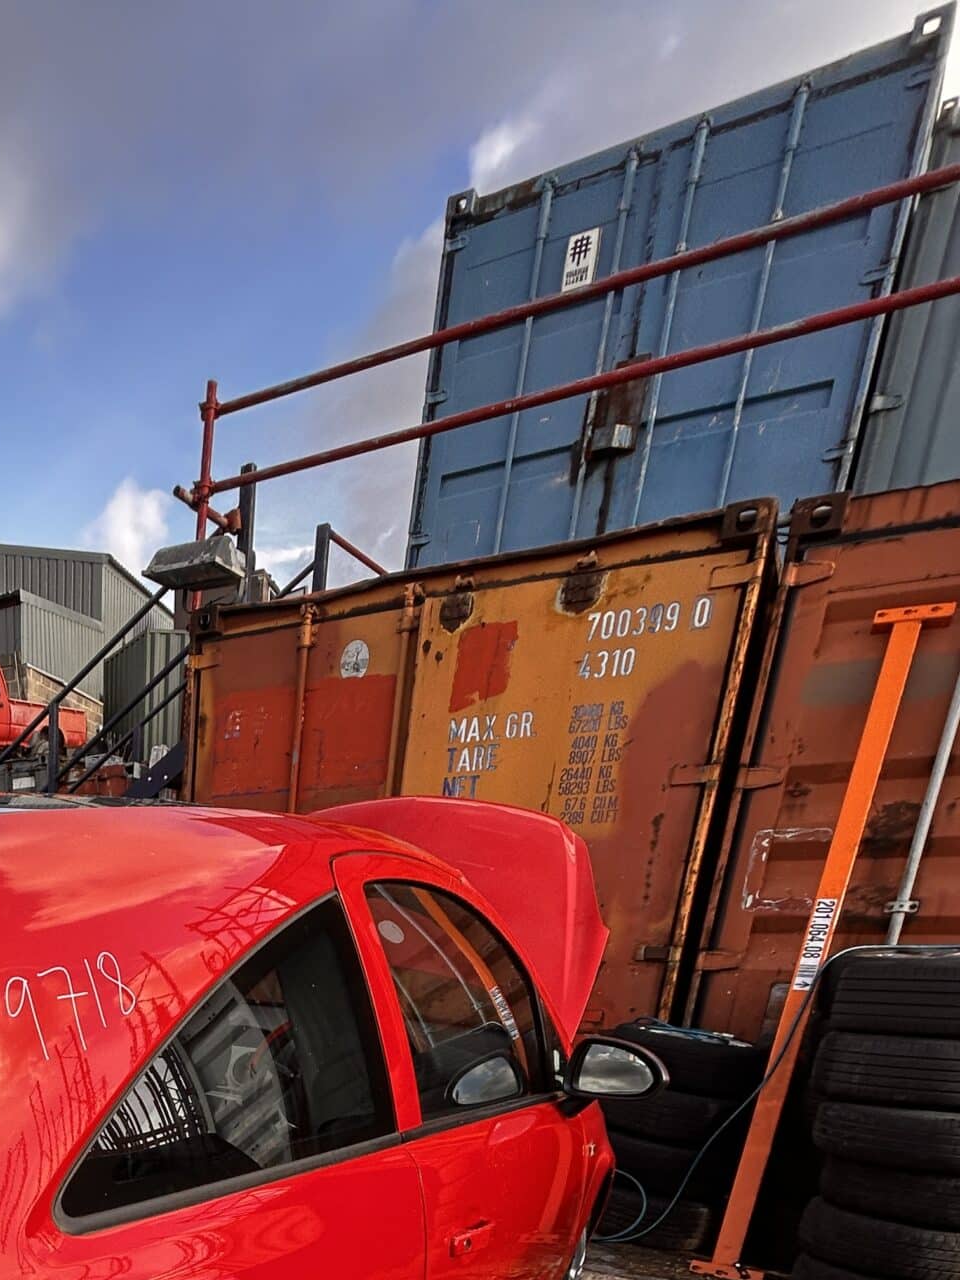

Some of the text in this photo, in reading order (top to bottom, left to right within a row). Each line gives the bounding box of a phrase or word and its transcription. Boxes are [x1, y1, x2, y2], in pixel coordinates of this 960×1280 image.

[587, 596, 712, 642] 700399 0
[579, 647, 636, 680] 4310
[608, 715, 628, 731] LBS
[603, 733, 618, 748] KG
[447, 744, 500, 773] TARE
[601, 747, 622, 763] LBS
[599, 765, 613, 780] KG
[596, 779, 617, 794] LBS
[802, 901, 836, 958] 201.064.08
[5, 951, 136, 1060] 9718
